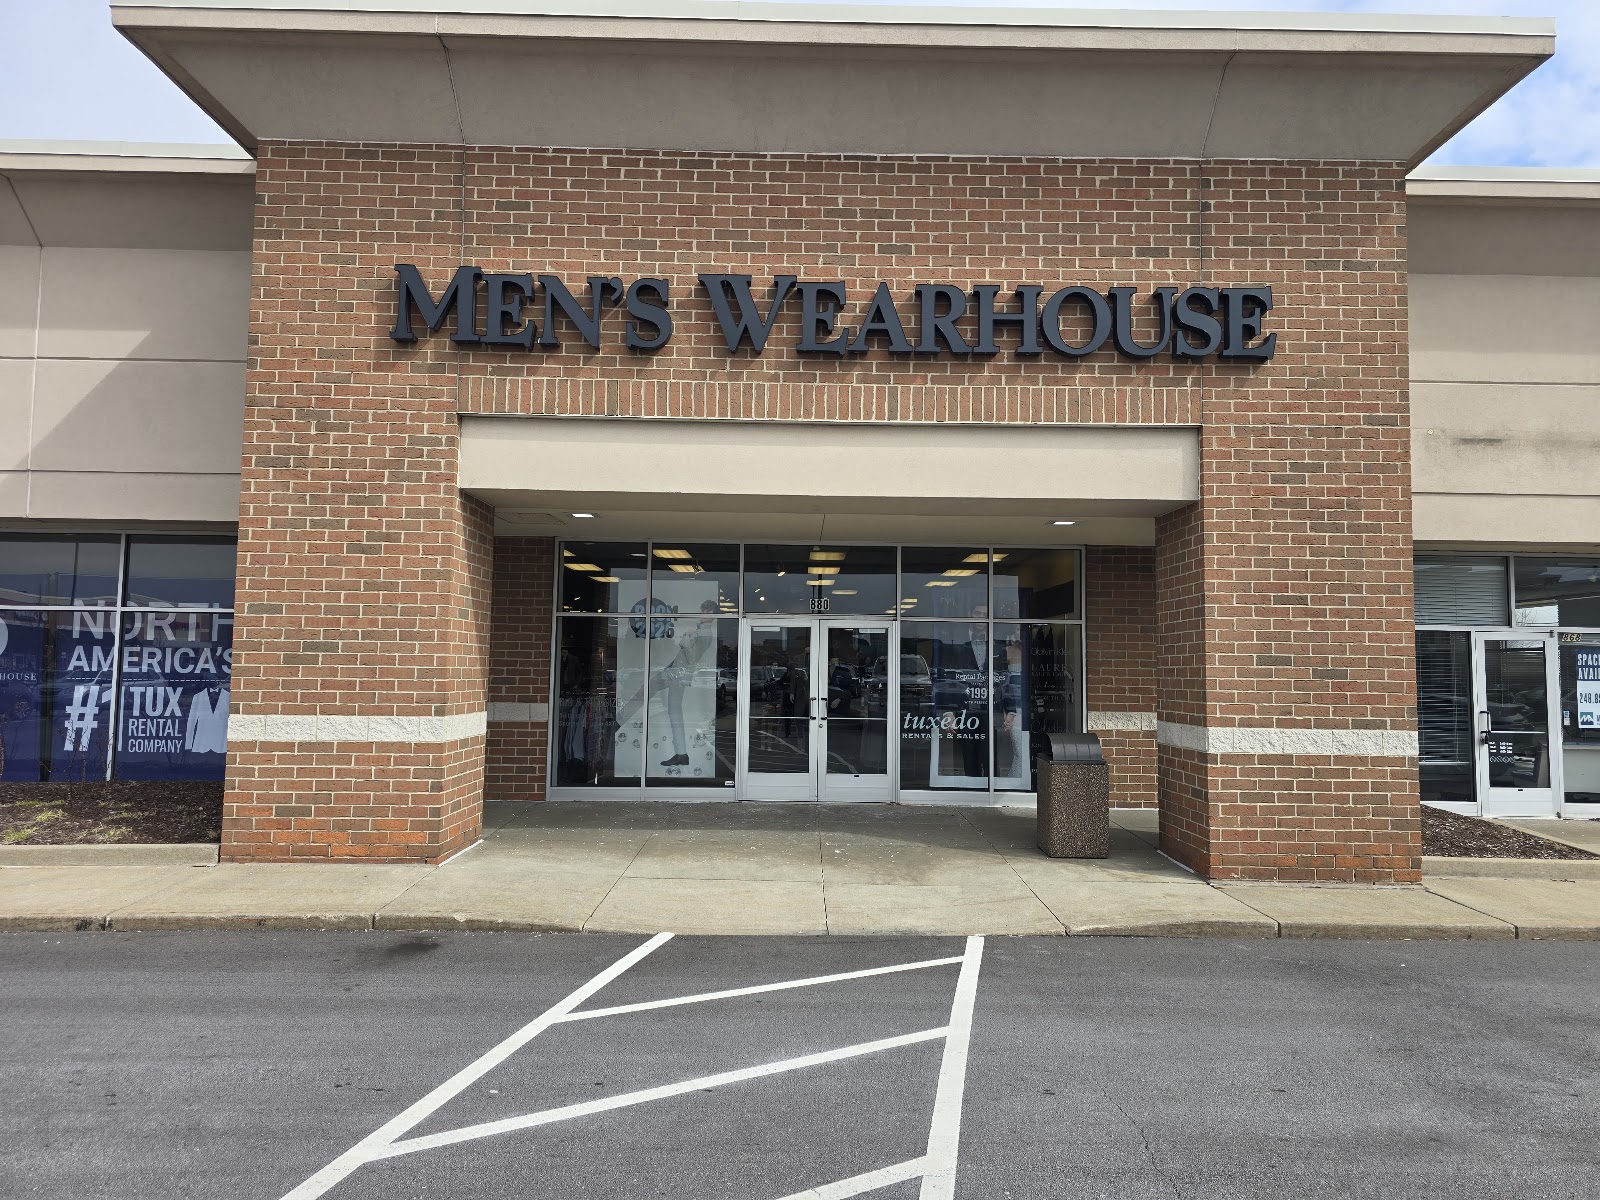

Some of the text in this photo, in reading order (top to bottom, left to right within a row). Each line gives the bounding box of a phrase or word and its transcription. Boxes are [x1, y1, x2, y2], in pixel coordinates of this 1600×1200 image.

[389, 263, 1277, 360] MEN'S WEARHOUSE
[634, 604, 679, 622] POM
[810, 599, 829, 610] 880
[72, 599, 235, 642] NORTH
[1562, 633, 1581, 642] 868
[67, 645, 233, 674] AMERICA'S
[1577, 653, 1600, 666] SPAC
[977, 672, 1006, 682] Pacges
[1579, 667, 1600, 680] AVAI
[129, 686, 184, 717] TUX
[64, 685, 126, 752] #1
[128, 718, 183, 737] RENTAL
[903, 709, 980, 730] tuxedo
[128, 739, 183, 754] COMPANY
